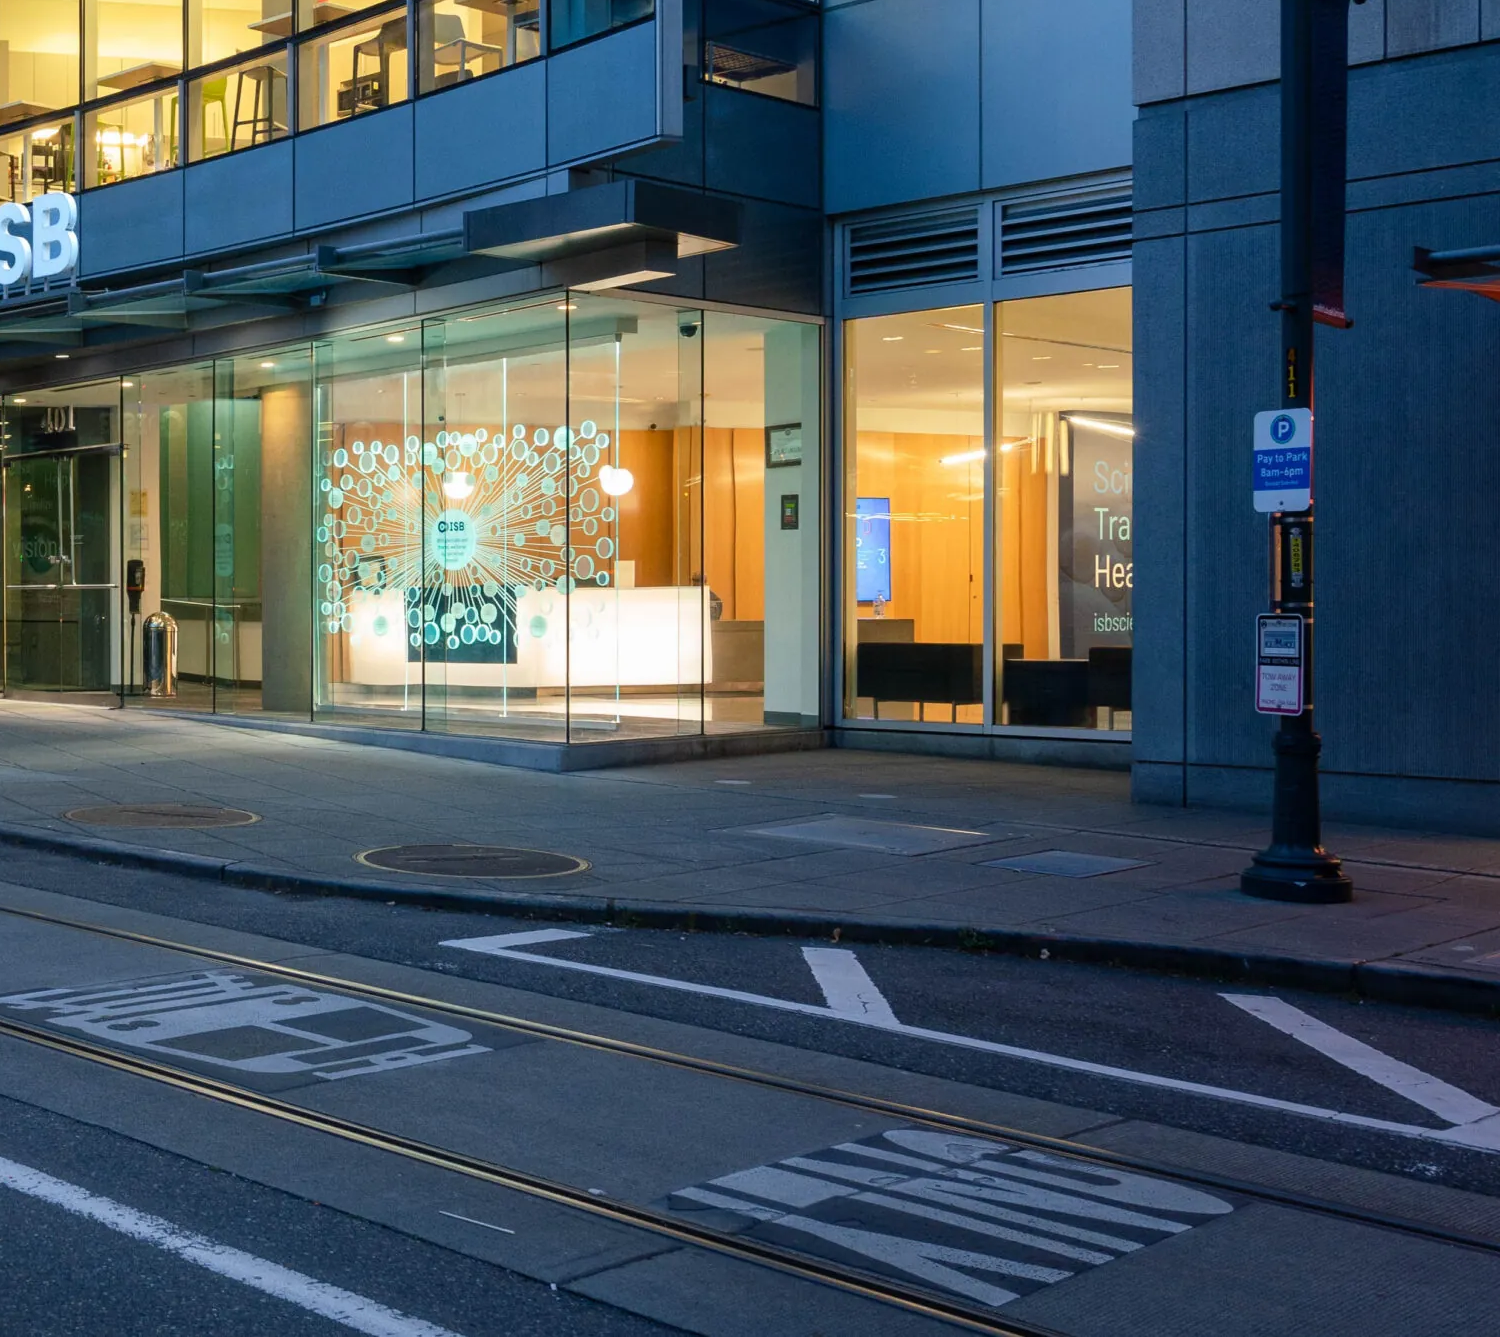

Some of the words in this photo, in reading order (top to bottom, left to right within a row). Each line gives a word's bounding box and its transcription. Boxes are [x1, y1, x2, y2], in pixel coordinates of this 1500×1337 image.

[1278, 421, 1290, 438] P
[1257, 455, 1273, 465] Pay
[1275, 453, 1284, 463] to
[1286, 451, 1308, 462] Park
[1260, 466, 1304, 479] 8am-6pm
[449, 521, 465, 532] ISB
[1094, 507, 1131, 541] Tra
